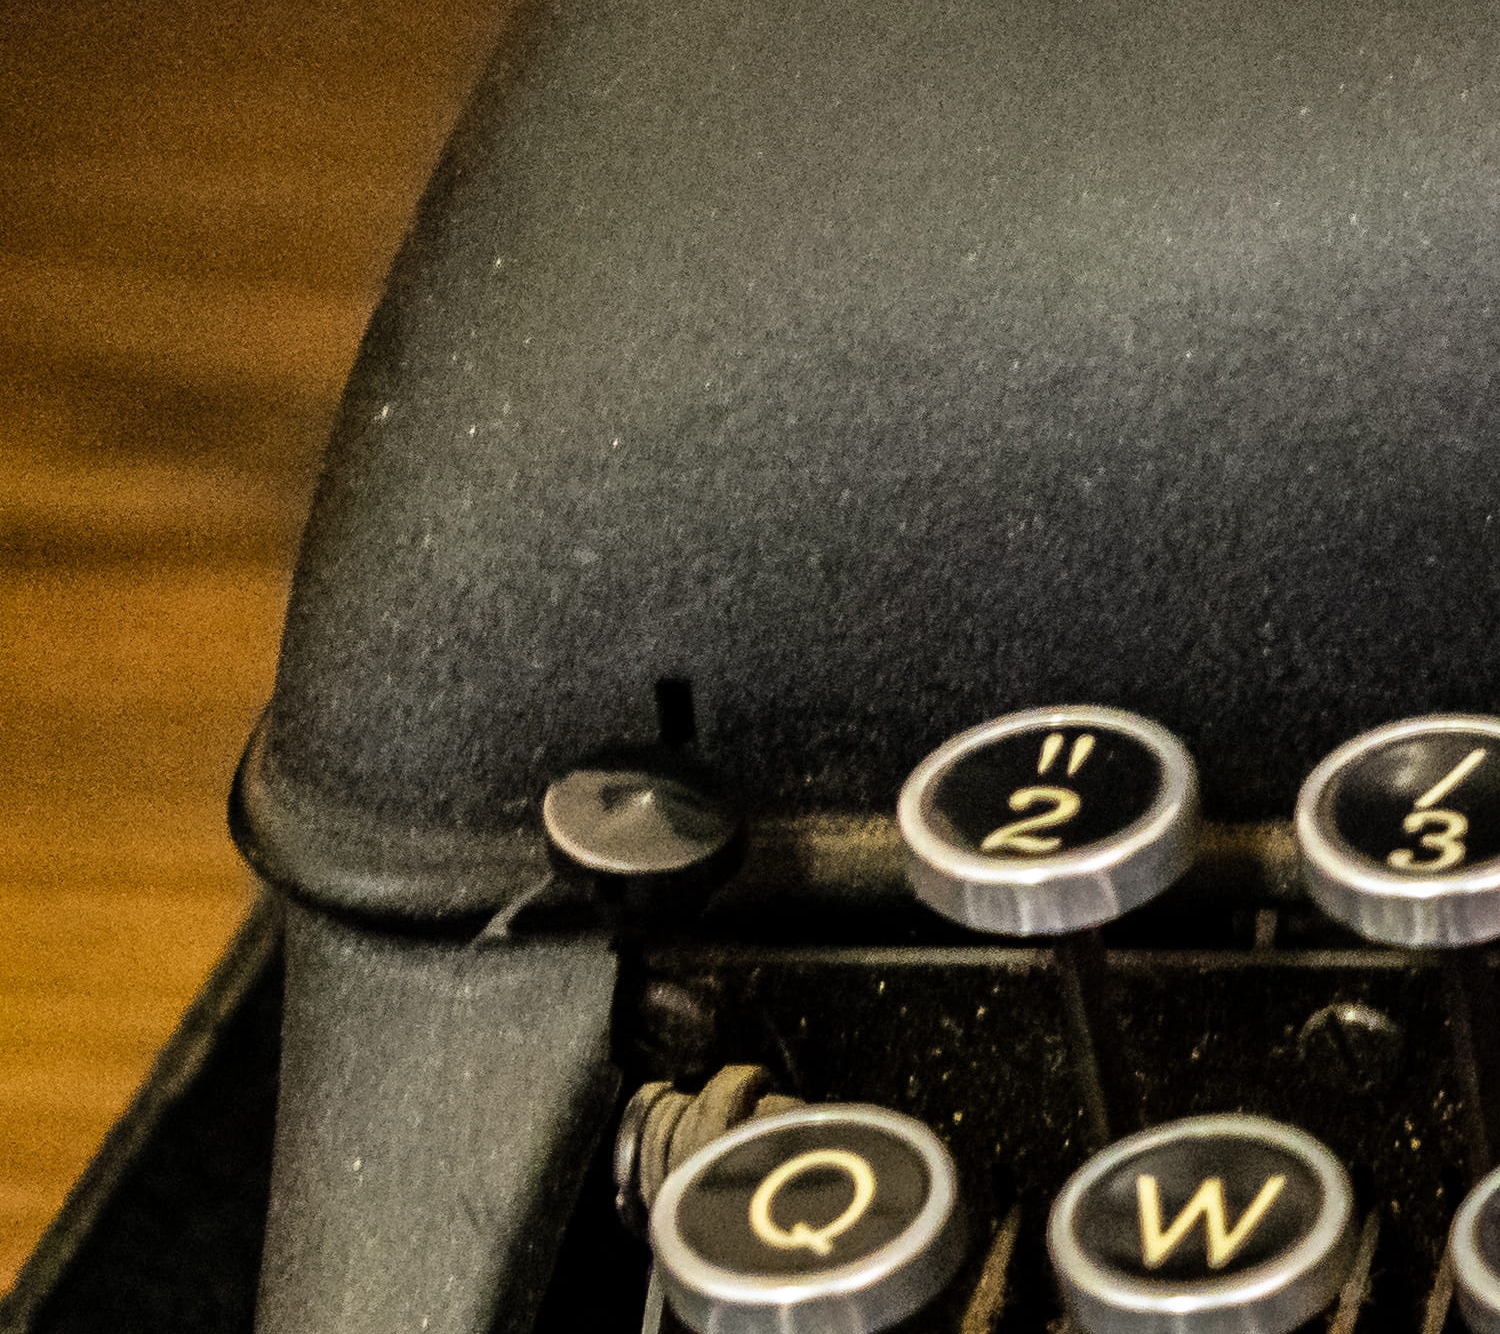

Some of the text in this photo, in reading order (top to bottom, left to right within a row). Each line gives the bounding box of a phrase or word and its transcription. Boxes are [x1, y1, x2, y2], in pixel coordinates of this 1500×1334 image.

[982, 785, 1082, 854] 2
[1390, 809, 1467, 871] 3
[749, 1149, 876, 1255] Q
[1135, 1173, 1286, 1264] W
